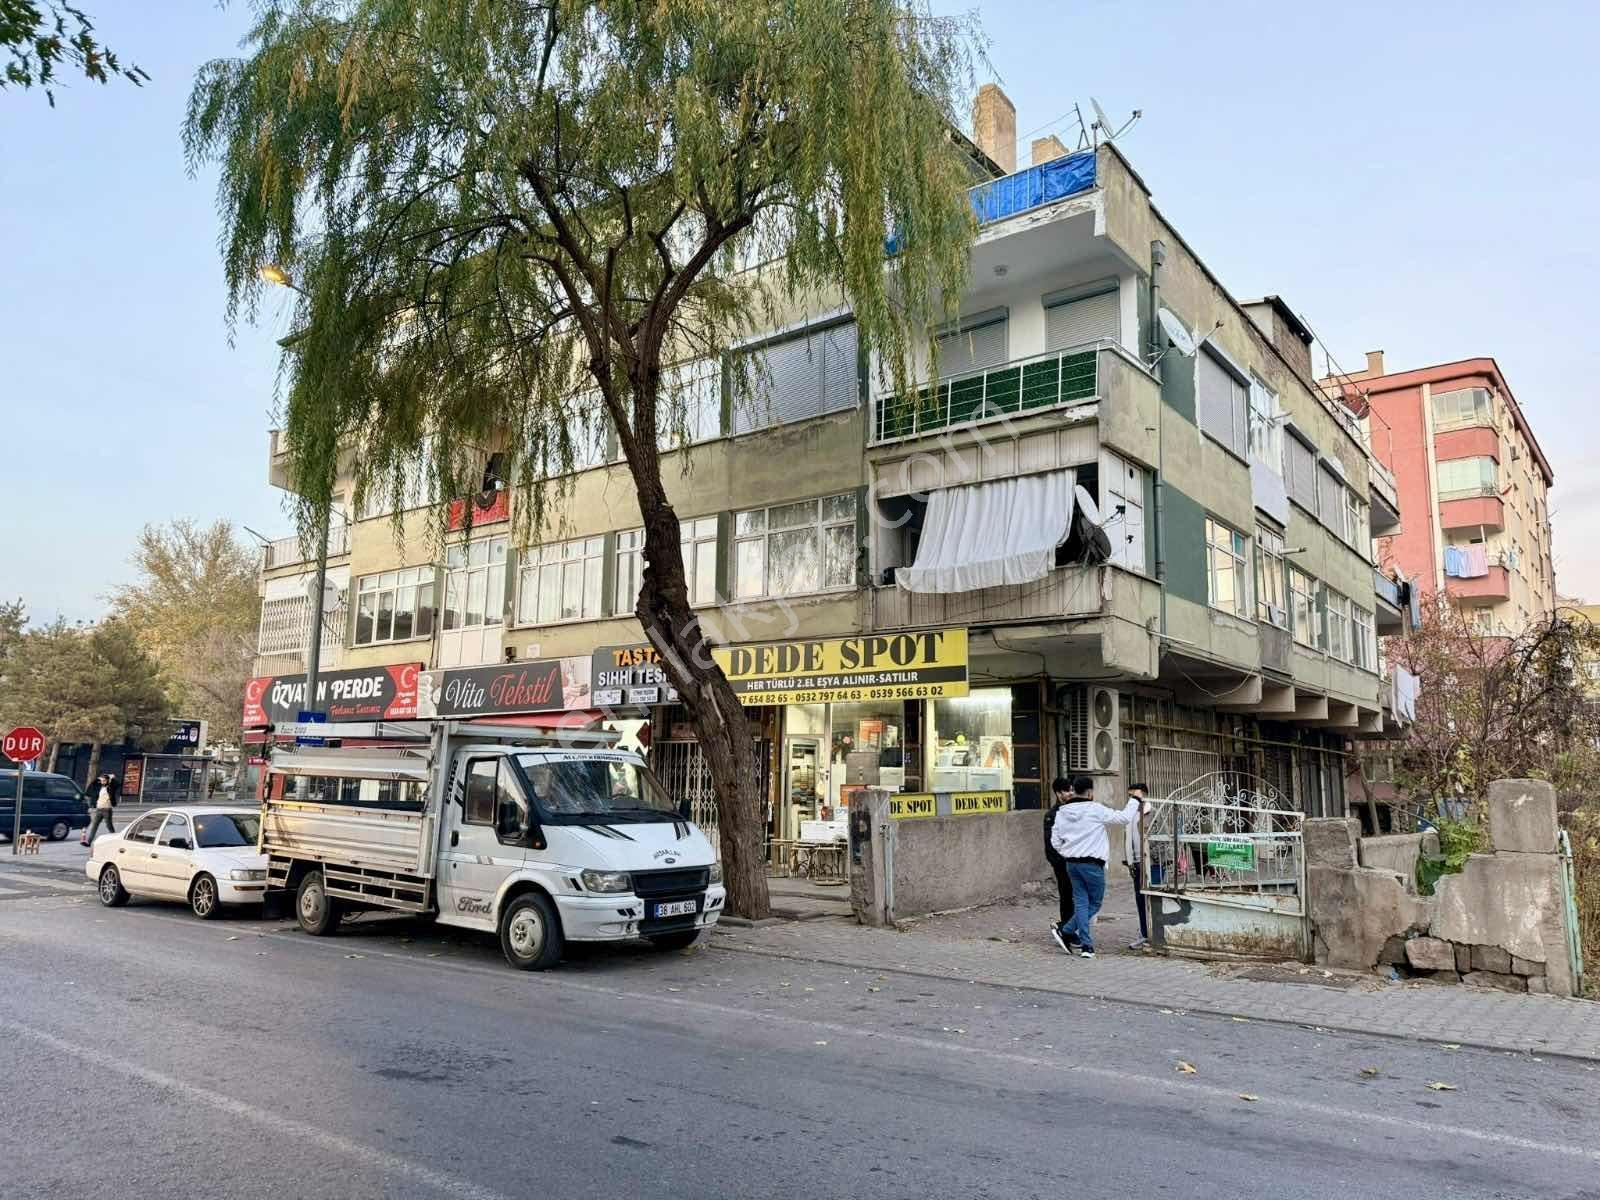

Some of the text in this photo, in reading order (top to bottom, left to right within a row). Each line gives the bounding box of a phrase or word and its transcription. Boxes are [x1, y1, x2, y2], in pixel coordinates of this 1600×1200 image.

[728, 632, 944, 676] DEDE SPOT
[445, 678, 487, 709] Vita
[490, 665, 560, 706] Tekstil
[747, 671, 918, 691] HER TÜRLÜ 2.EL EŞYA ALINIR-SATILIR
[272, 676, 384, 709] ÖZVATN PERDE
[748, 695, 763, 704] 654
[766, 694, 776, 703] 82
[777, 694, 788, 703] 65
[795, 693, 816, 702] 0532
[819, 692, 834, 701] 797
[837, 691, 848, 700] 64
[850, 690, 861, 699] 63
[870, 689, 893, 698] 0539
[896, 688, 914, 697] 566
[916, 687, 928, 696] 63
[931, 686, 943, 695] 02
[6, 737, 41, 751] DUR
[890, 799, 932, 814] DE SPOT
[955, 796, 1003, 810] DEDE SPOT
[457, 896, 493, 914] Ford
[660, 905, 668, 916] 38
